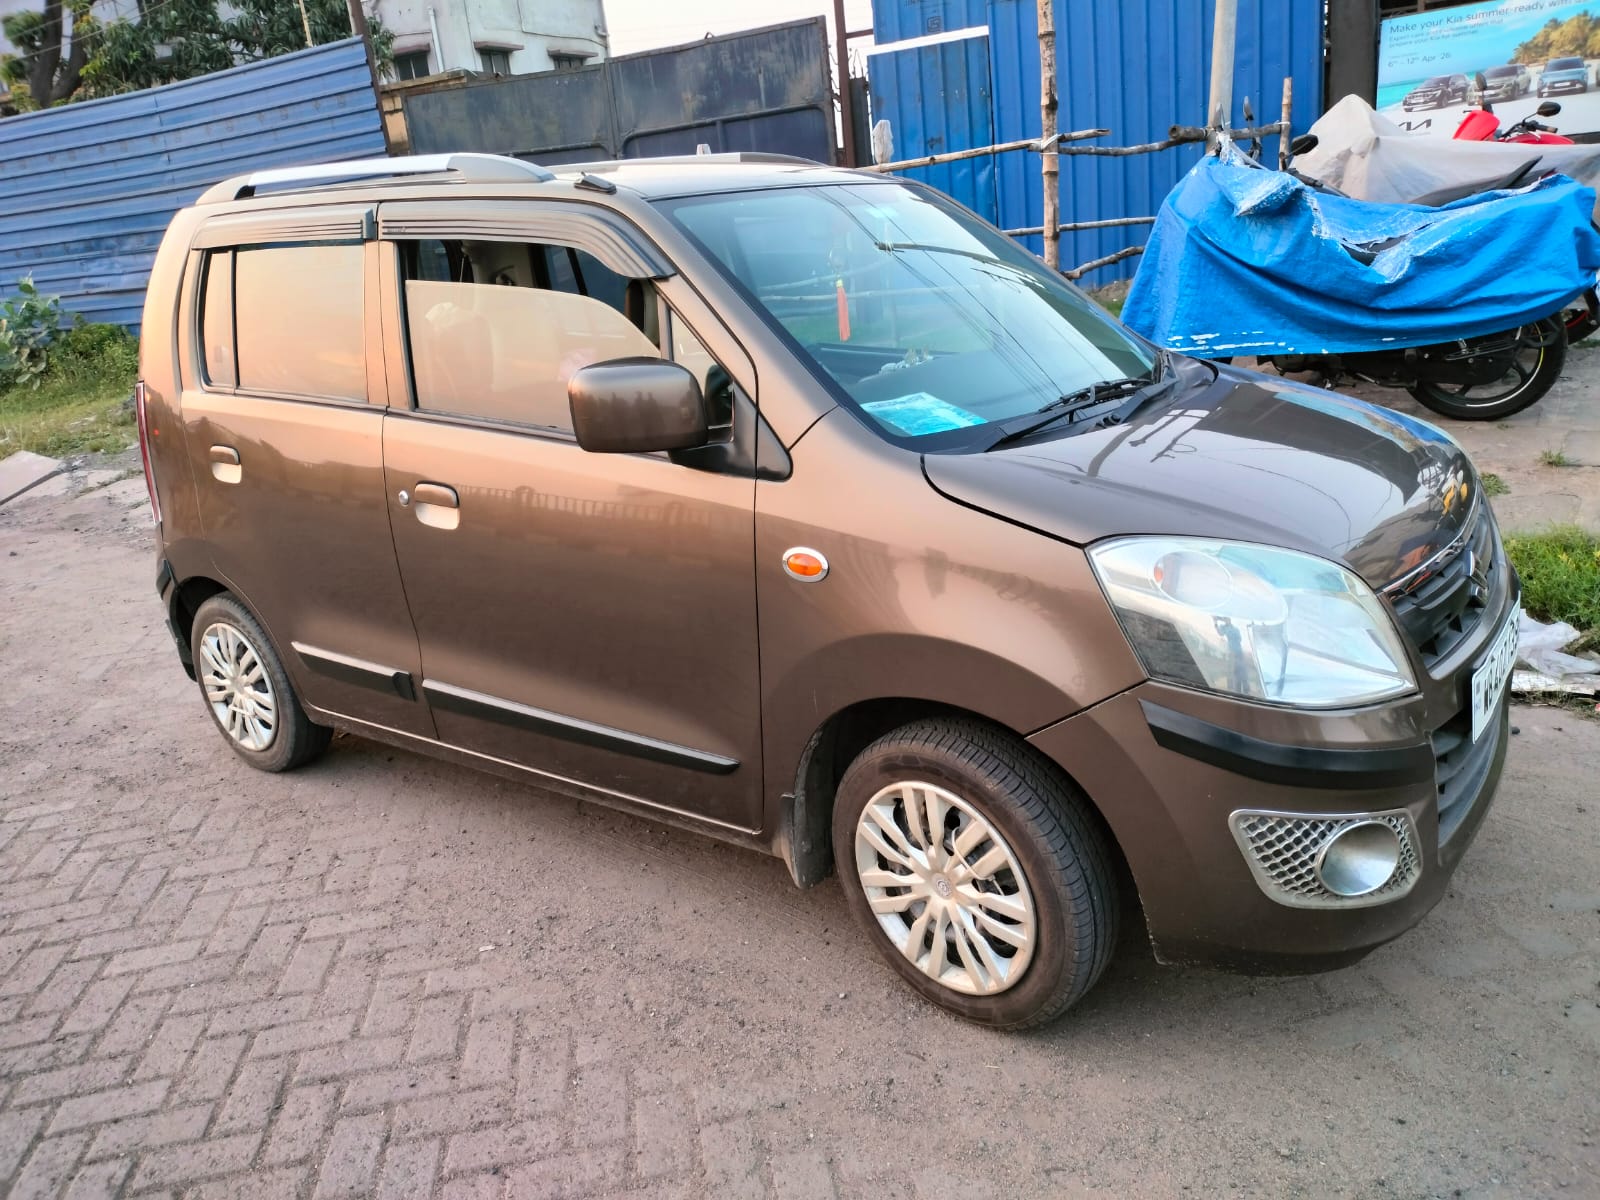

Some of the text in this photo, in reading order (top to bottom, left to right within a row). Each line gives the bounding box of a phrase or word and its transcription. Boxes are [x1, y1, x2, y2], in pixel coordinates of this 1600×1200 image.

[1389, 23, 1417, 34] Make
[1420, 18, 1443, 30] your
[1446, 15, 1463, 25] Kia
[1421, 55, 1436, 65] Apr
